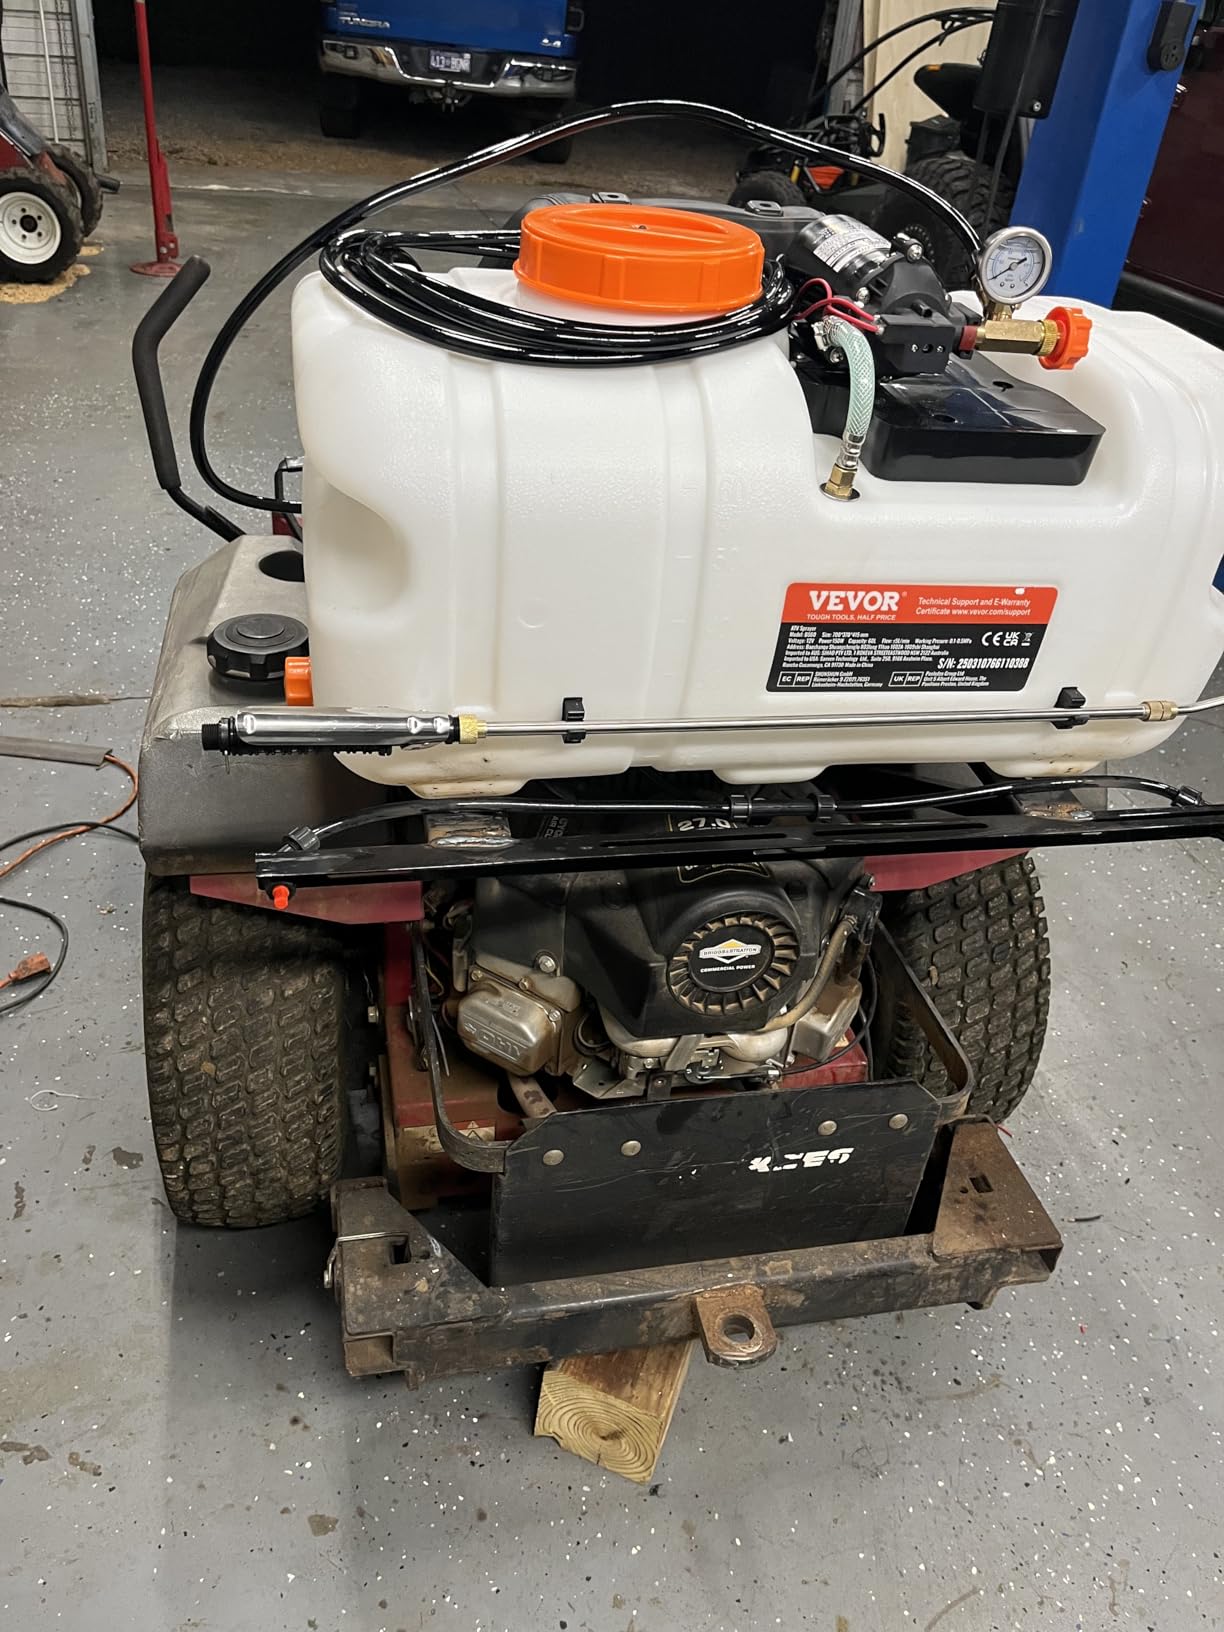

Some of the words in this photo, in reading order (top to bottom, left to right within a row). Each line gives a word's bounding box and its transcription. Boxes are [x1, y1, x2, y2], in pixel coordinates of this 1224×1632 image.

[808, 590, 900, 611] VEVOR
[918, 597, 950, 606] Technical
[951, 598, 978, 608] Support
[979, 598, 992, 606] and
[993, 598, 1031, 608] E-Warranty
[916, 607, 951, 615] Certificate
[951, 608, 1031, 616] www.vevor.com/support
[1005, 631, 1020, 639] UK
[937, 657, 955, 669] S/N:
[700, 965, 735, 973] COMMERCIAL
